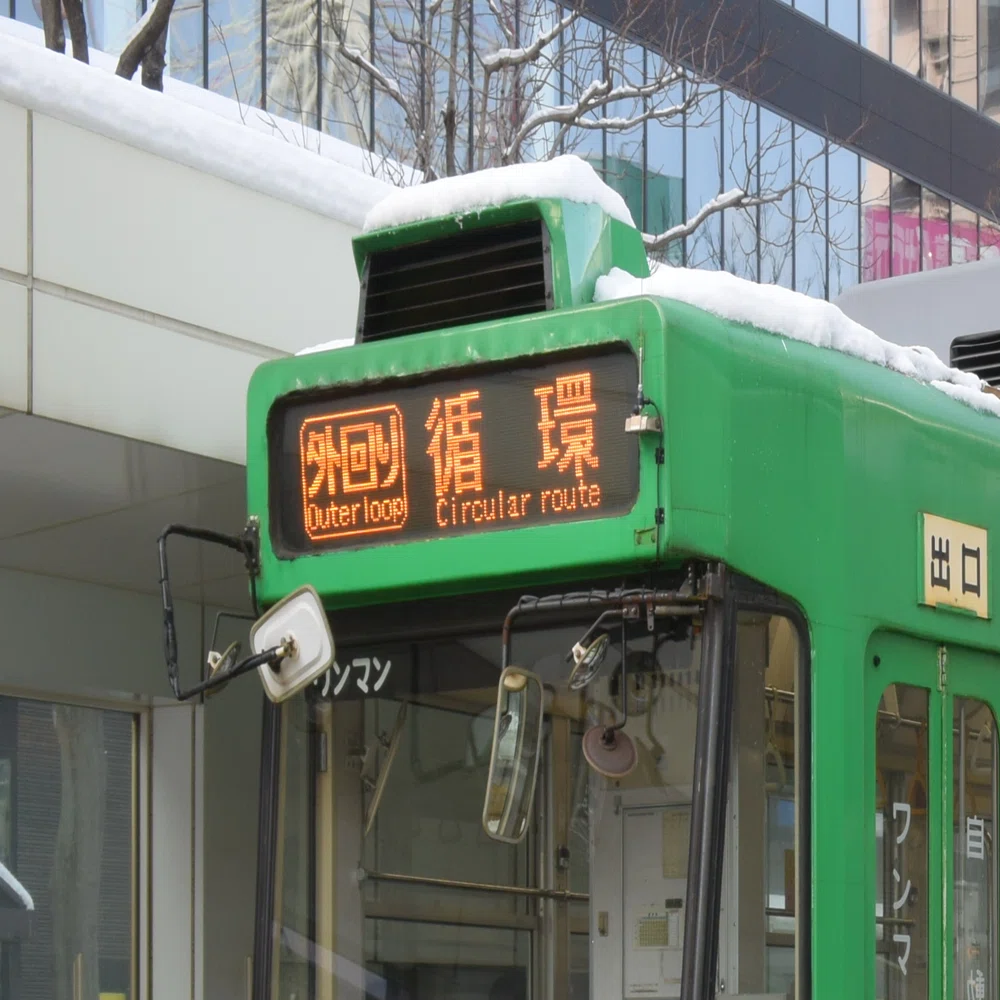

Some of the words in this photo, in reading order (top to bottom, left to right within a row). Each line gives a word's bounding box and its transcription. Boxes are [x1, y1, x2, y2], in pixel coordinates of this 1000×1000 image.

[306, 414, 402, 499] 外回り
[307, 500, 360, 531] Outer
[364, 496, 404, 523] loop
[436, 490, 532, 527] Circular
[541, 481, 602, 515] route
[930, 535, 982, 598] 出口
